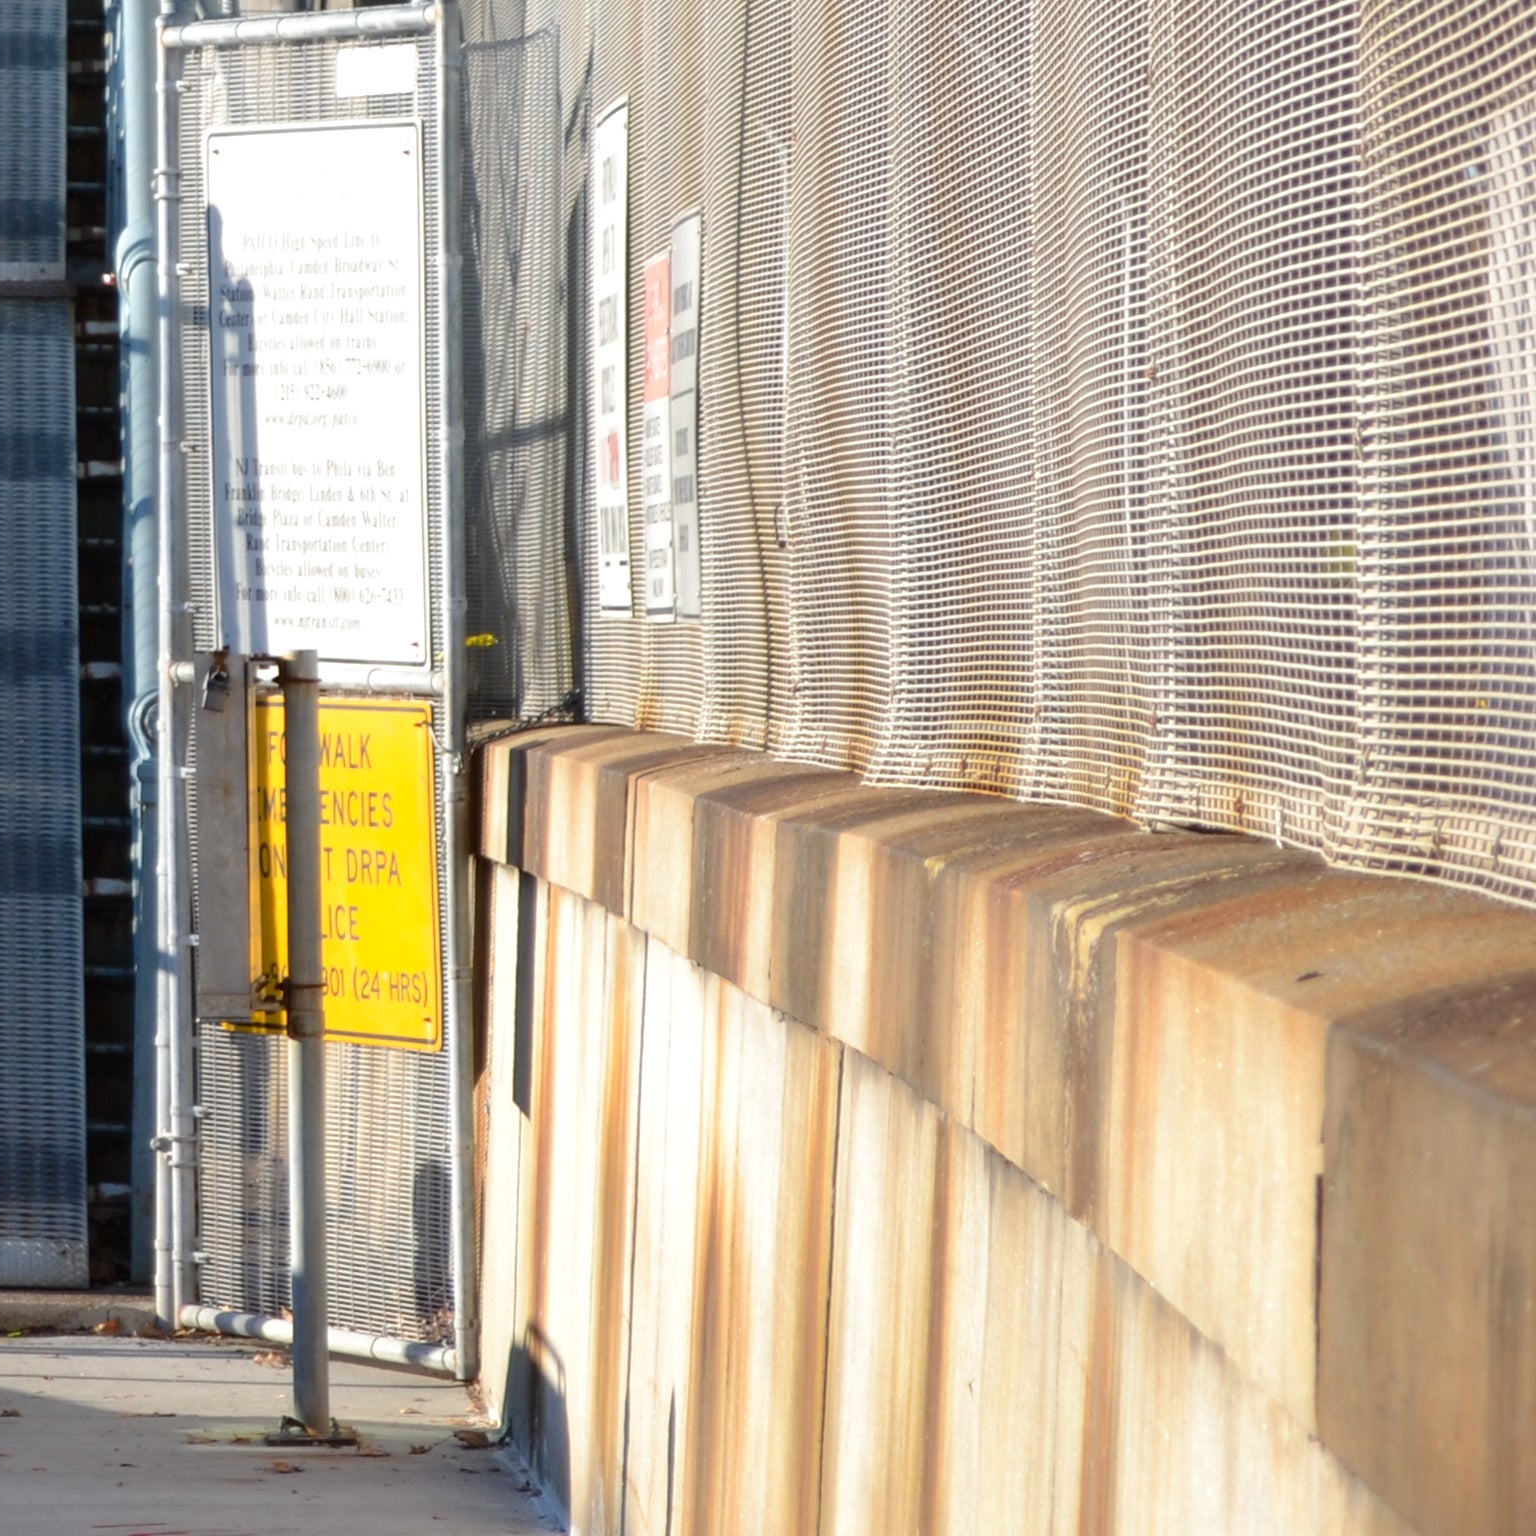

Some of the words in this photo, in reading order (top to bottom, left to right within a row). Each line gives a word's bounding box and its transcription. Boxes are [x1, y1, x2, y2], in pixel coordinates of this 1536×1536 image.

[281, 233, 304, 252] High
[310, 234, 338, 252] Speed
[344, 231, 365, 248] Line
[300, 283, 324, 300] Rand
[331, 282, 407, 301] Transportation
[271, 309, 309, 325] Camden
[340, 306, 362, 324] Hall
[289, 334, 325, 351] allowed
[329, 338, 341, 350] on
[269, 359, 289, 376] info
[293, 358, 310, 375] call
[394, 361, 406, 375] or
[236, 457, 248, 477] NJ
[251, 457, 287, 477] Transit
[291, 462, 308, 476] bus
[312, 463, 322, 476] to
[327, 458, 353, 477] Phila
[357, 464, 372, 477] via
[377, 459, 396, 477] Ben
[223, 481, 265, 502] Franklin
[309, 484, 342, 502] Linden
[347, 485, 355, 503] &
[359, 485, 377, 503] 6th
[399, 489, 409, 503] at
[236, 506, 266, 528] Bridge
[272, 509, 299, 527] Plaza
[303, 514, 314, 527] or
[317, 510, 358, 528] Camden
[361, 510, 397, 529] Walter
[245, 531, 270, 553] Rand
[275, 533, 348, 554] Transportation
[254, 557, 294, 577] Bicycles
[297, 559, 334, 578] allowed
[338, 565, 350, 578] on
[234, 581, 253, 602] For
[254, 587, 279, 602] more
[283, 584, 303, 602] info
[306, 585, 325, 603] call
[316, 732, 372, 769] WALK
[257, 785, 394, 829] MEENCIES
[346, 848, 402, 886] DRPA
[353, 966, 380, 1002] (24
[389, 970, 428, 1008] HRS)
